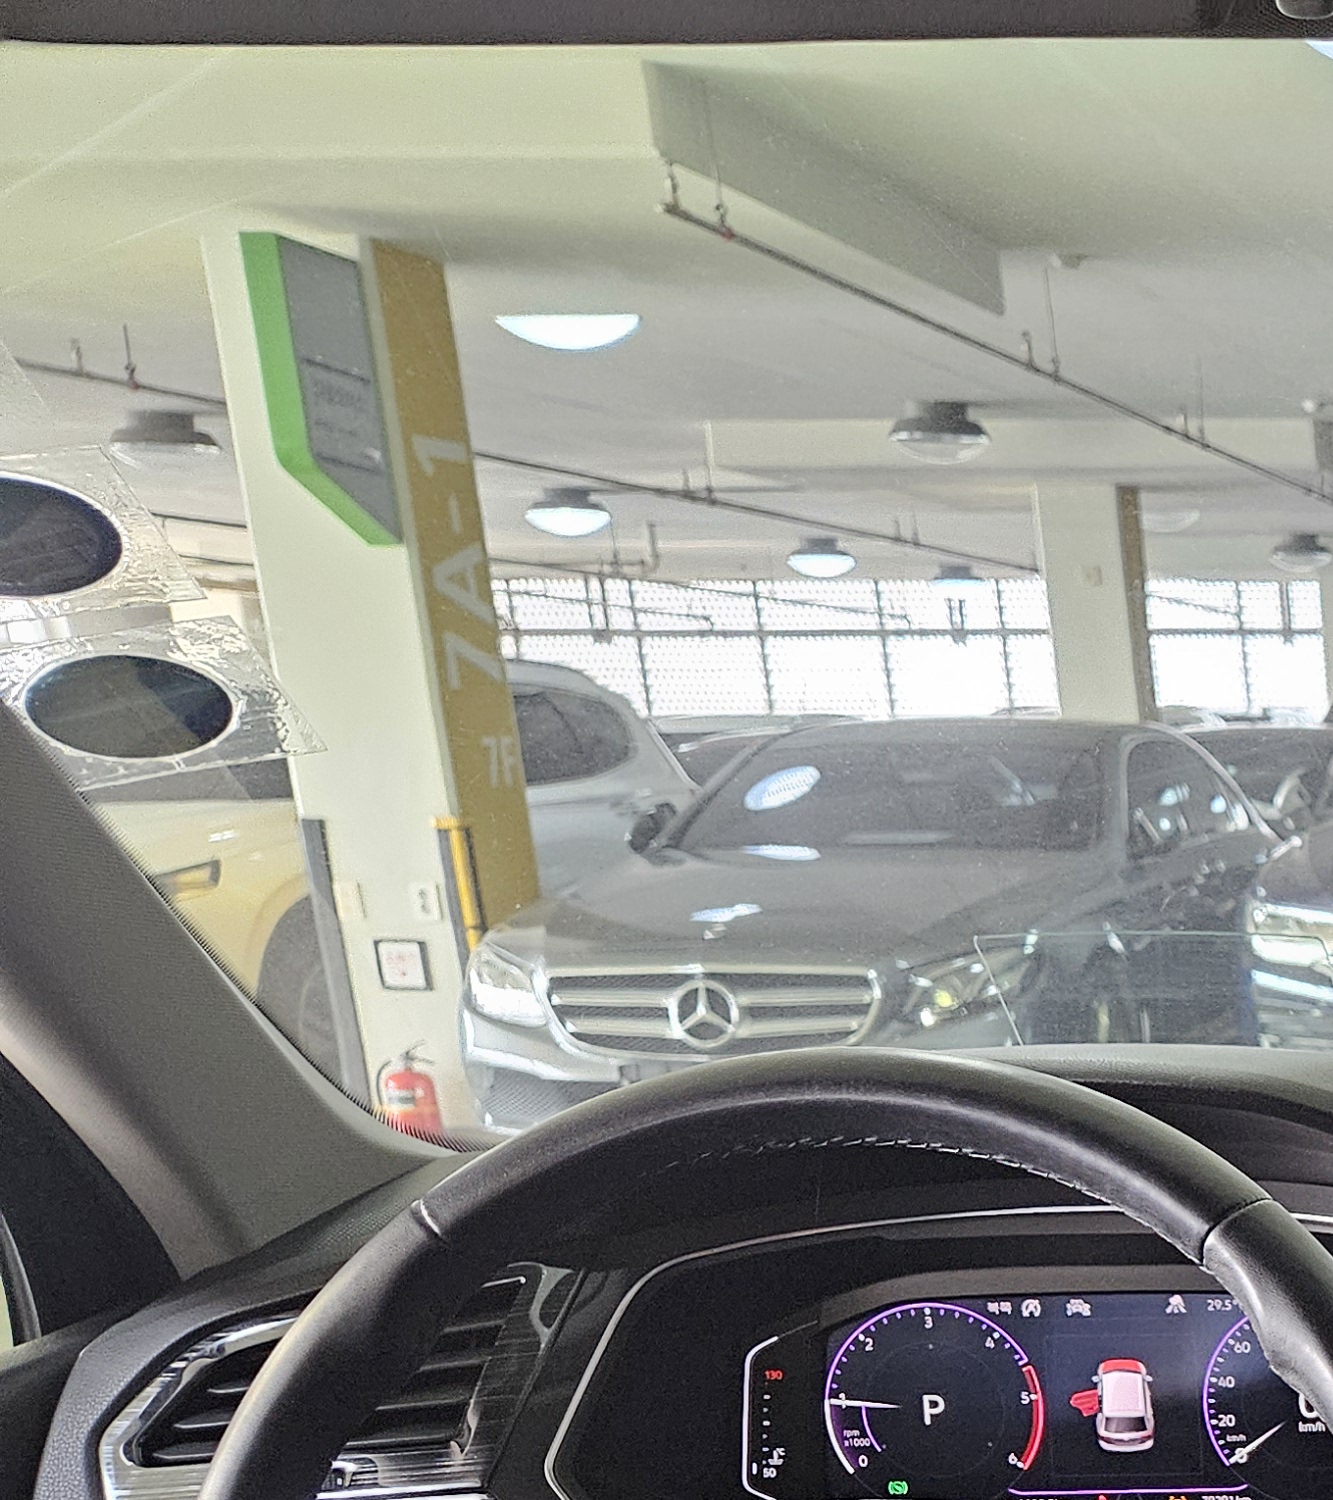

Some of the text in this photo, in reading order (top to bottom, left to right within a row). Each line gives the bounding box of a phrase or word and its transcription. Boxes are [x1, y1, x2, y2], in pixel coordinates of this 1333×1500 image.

[411, 432, 507, 691] 7A-1
[480, 735, 518, 788] 7F
[924, 1315, 933, 1329] 3
[864, 1338, 874, 1351] 2
[985, 1336, 995, 1349] 4
[1233, 1341, 1251, 1354] 60
[764, 1370, 783, 1381] 130
[1217, 1376, 1235, 1388] 40
[1020, 1391, 1030, 1405] 5
[922, 1394, 945, 1426] P
[1217, 1414, 1236, 1427] 20
[1298, 1421, 1326, 1433] km/h
[843, 1429, 860, 1439] rpm
[858, 1454, 868, 1468] 0
[1008, 1453, 1018, 1465] 6
[763, 1467, 777, 1479] 50
